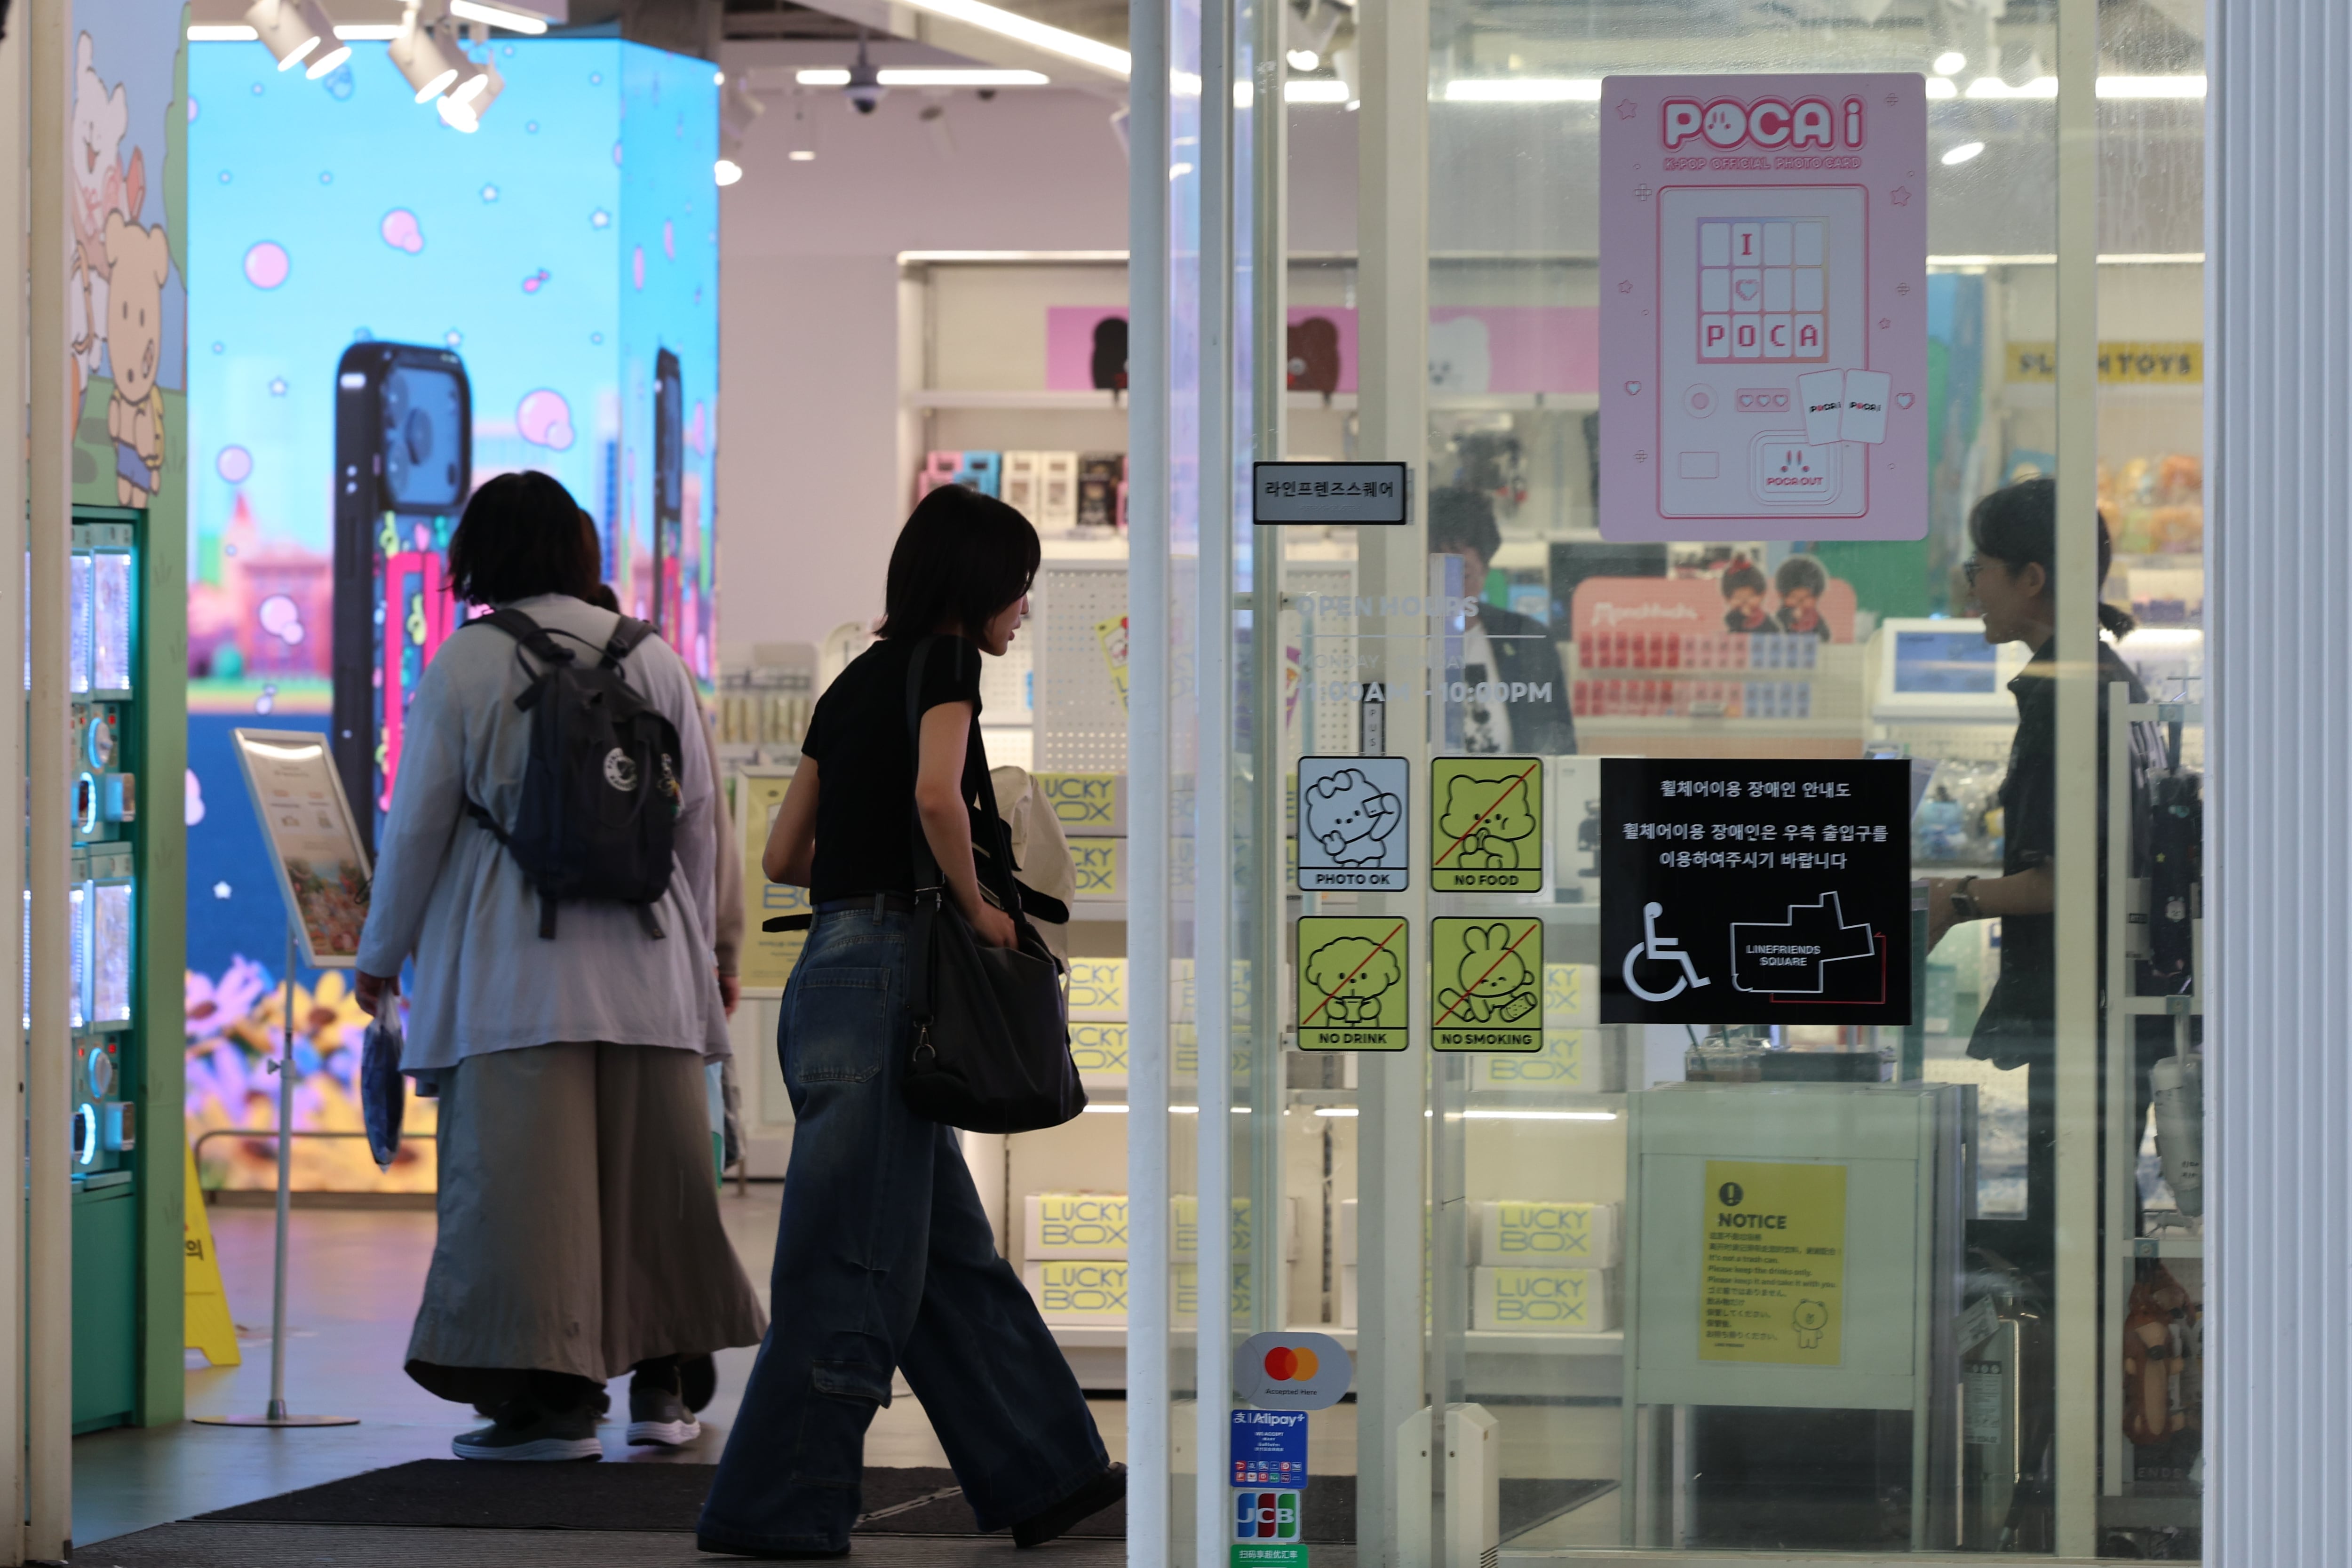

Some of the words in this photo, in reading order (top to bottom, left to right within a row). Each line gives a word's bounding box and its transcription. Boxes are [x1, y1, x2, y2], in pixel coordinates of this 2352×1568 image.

[1665, 157, 1706, 170] K-POP
[1711, 157, 1771, 170] OFFICIAL
[2019, 353, 2111, 374] PLH
[1266, 481, 1394, 498] 라인프렌즈스퀘어
[1767, 477, 1798, 486] POCA
[1296, 596, 1373, 617] OPEN
[1380, 596, 1479, 617] HOURS
[1440, 681, 1552, 703] 10:00PM
[1045, 778, 1112, 798] UCKY
[1660, 780, 1741, 798] 휠체어이용
[1747, 781, 1796, 798] 장애인
[1802, 782, 1851, 799] 안내도
[1054, 801, 1111, 821] OX
[1622, 822, 1706, 841] 휠체어이용
[1710, 823, 1777, 841] 장애인은
[1782, 825, 1816, 842] 우측
[1821, 825, 1888, 842] 출입구를
[1659, 851, 1774, 868] 이용하여주시기
[1780, 852, 1847, 869] 바랍니다
[1316, 874, 1367, 885] PHOTO
[1371, 874, 1390, 885] OK
[1454, 875, 1475, 886] NO
[1479, 875, 1519, 886] FOOD
[1746, 945, 1821, 955] LINEFRIENDS
[1759, 957, 1807, 966] SQUARE
[1070, 964, 1119, 984] CKY
[1069, 987, 1119, 1006] OX
[1319, 1033, 1340, 1044] NO
[1344, 1033, 1387, 1044] DRINK
[1442, 1034, 1462, 1045] NO
[1465, 1034, 1533, 1045] SMOKING
[1072, 1050, 1128, 1069] OX
[1491, 1059, 1577, 1081] BOX
[1042, 1202, 1128, 1222] LUCKY
[1501, 1209, 1588, 1229] LUCKY
[1718, 1213, 1787, 1229] NOTICE
[1042, 1224, 1128, 1245] BOX
[1500, 1231, 1588, 1252] BOX
[1043, 1267, 1128, 1288] LUCKY
[1735, 1266, 1751, 1274] keep
[1496, 1277, 1583, 1297] LUCKY
[1043, 1290, 1128, 1310] BOX
[1496, 1299, 1583, 1321] BOX
[1236, 1507, 1295, 1524] JCB
[1239, 1550, 1298, 1559] 扫码享超优汇率
